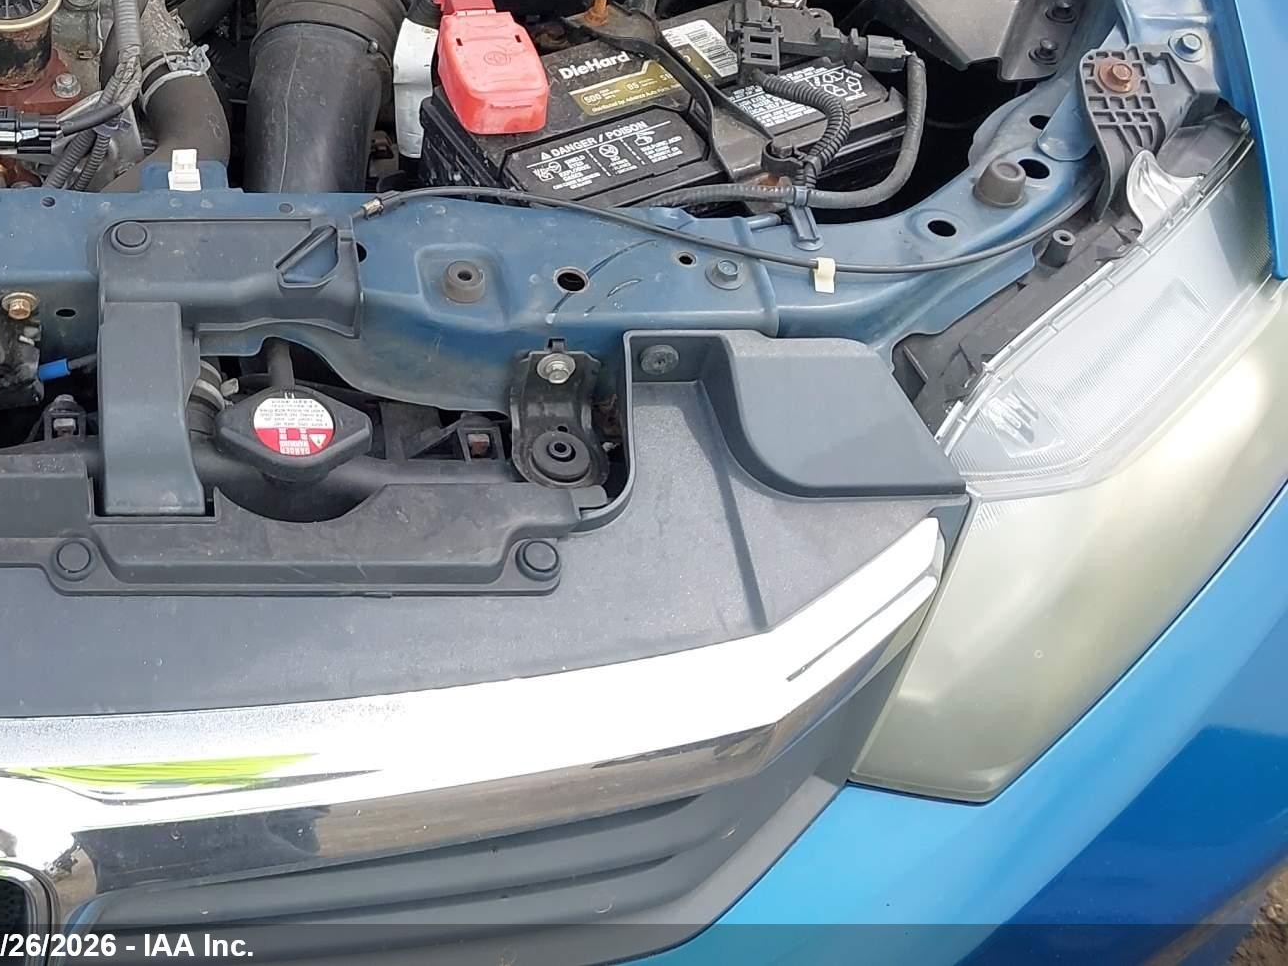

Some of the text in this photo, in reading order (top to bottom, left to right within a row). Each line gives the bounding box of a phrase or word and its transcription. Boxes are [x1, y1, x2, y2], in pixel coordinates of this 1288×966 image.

[558, 51, 630, 80] DieHard
[552, 137, 597, 157] DANGER
[606, 121, 648, 139] POISON
